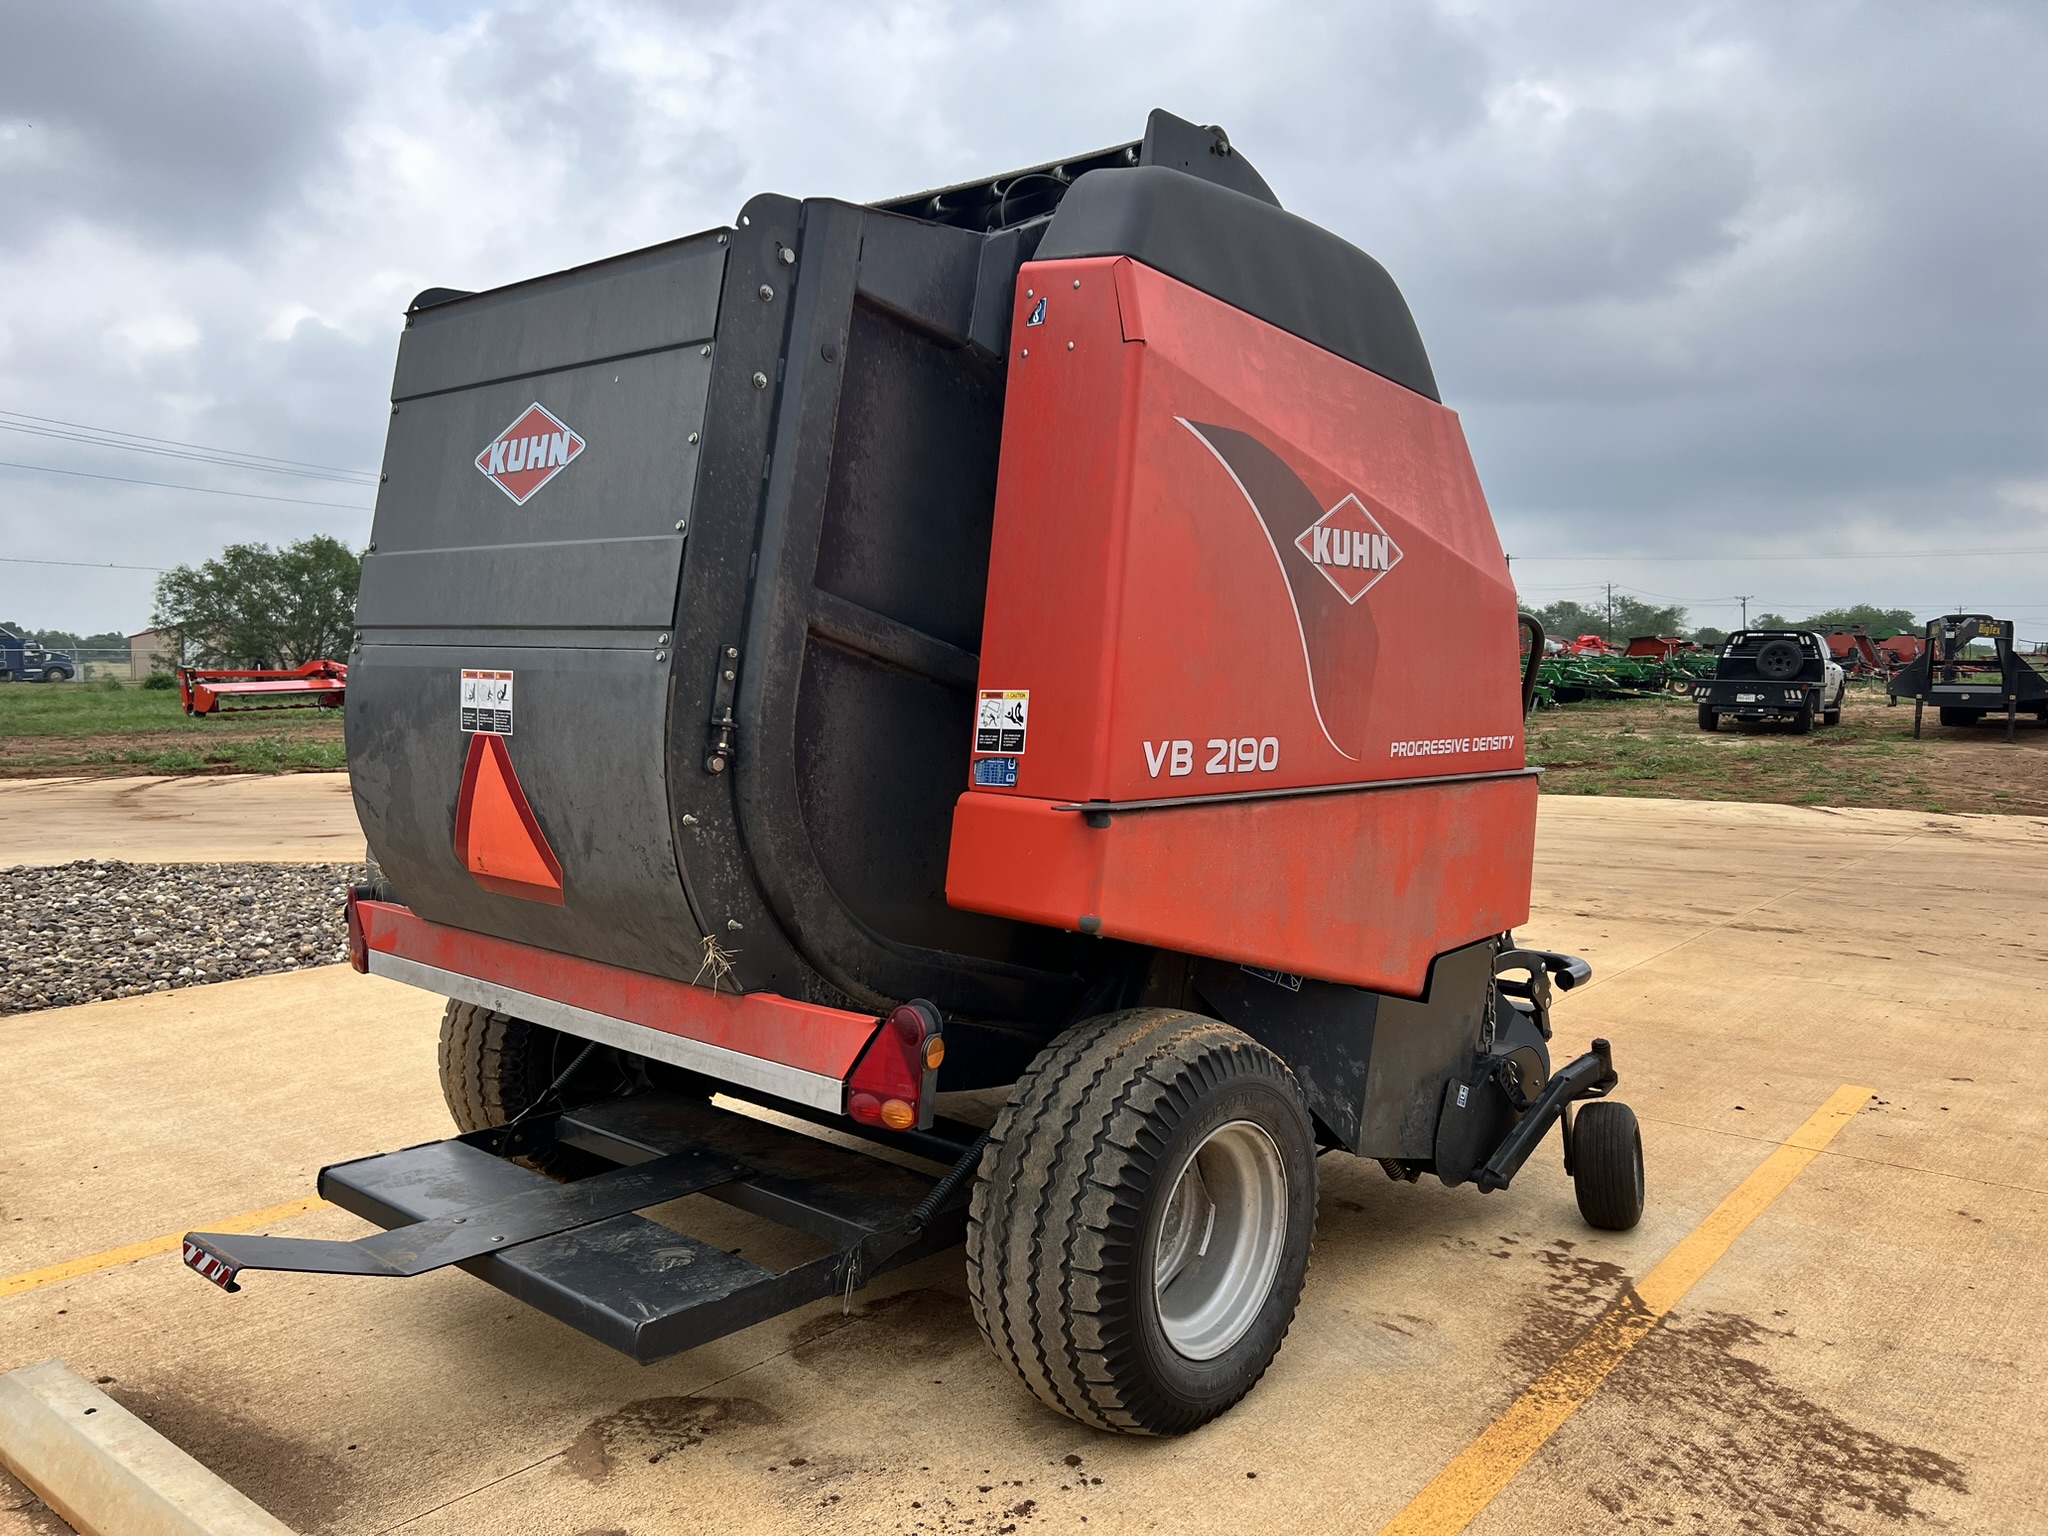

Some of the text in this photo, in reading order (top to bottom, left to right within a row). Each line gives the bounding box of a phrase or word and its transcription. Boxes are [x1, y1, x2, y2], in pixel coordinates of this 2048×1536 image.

[487, 430, 571, 476] KUHN
[1313, 525, 1389, 571] KUHN
[1142, 736, 1279, 778] VB 2190
[1390, 735, 1515, 757] PROGRESSIVE DENSITY
